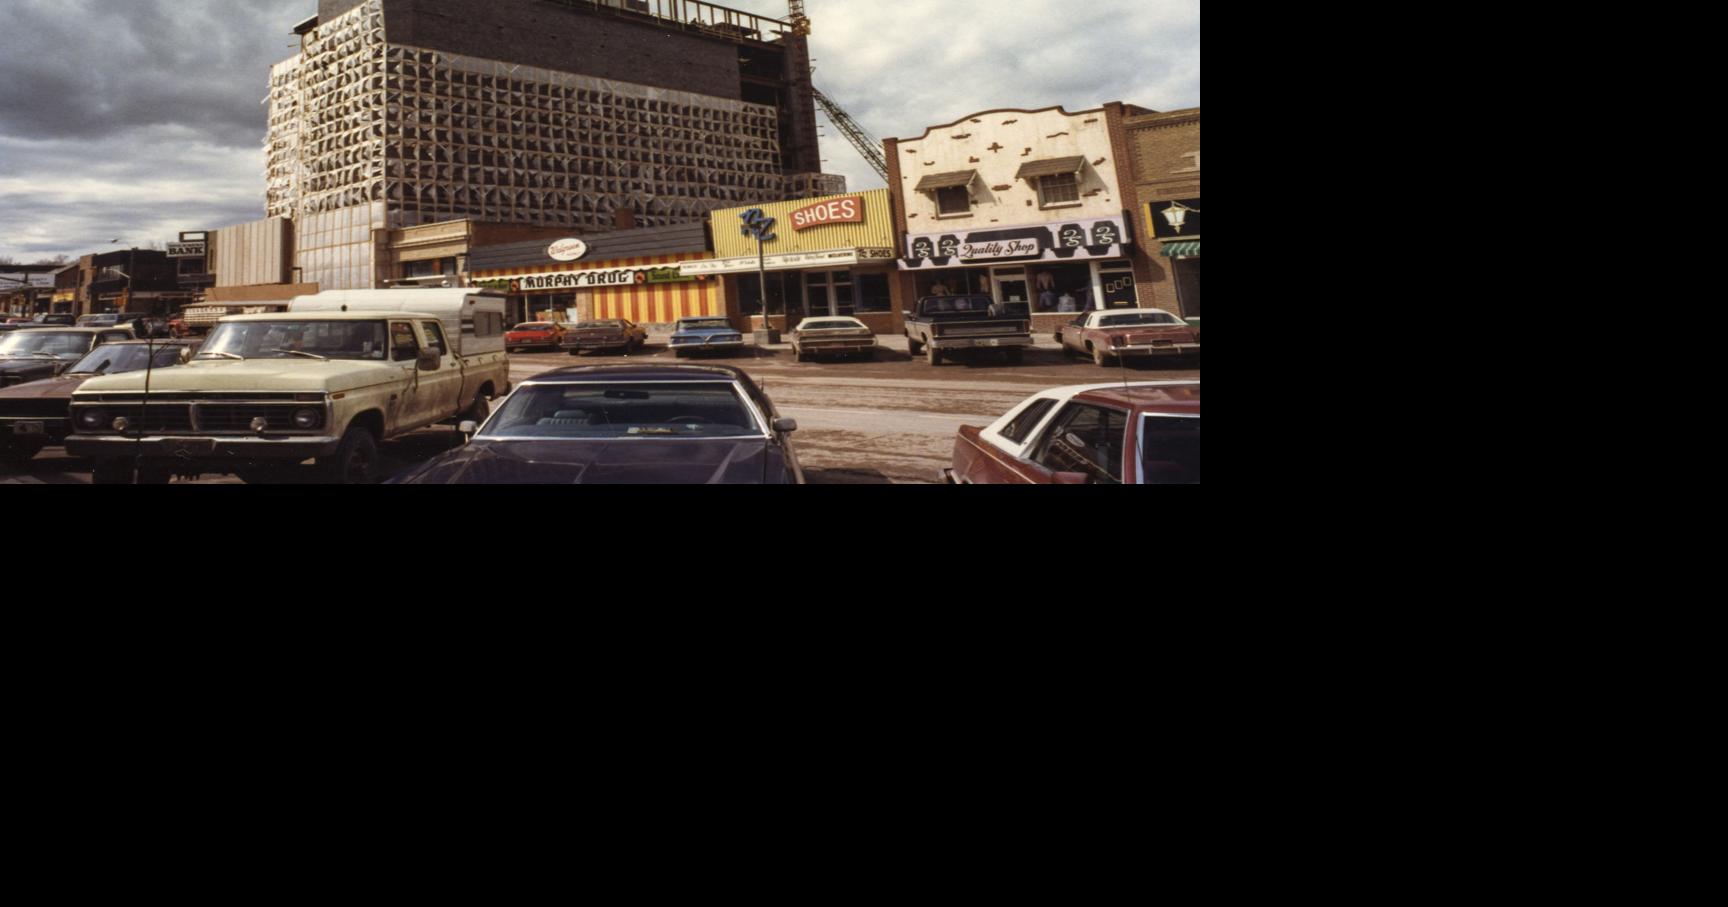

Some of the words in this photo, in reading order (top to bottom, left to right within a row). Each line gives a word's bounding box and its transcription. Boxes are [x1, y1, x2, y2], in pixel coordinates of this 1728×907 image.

[794, 199, 856, 226] SHOES
[168, 247, 203, 255] BANK
[870, 249, 891, 258] SHOES
[962, 242, 1004, 259] Quality
[1004, 240, 1036, 255] Shop
[587, 270, 629, 285] DRUG
